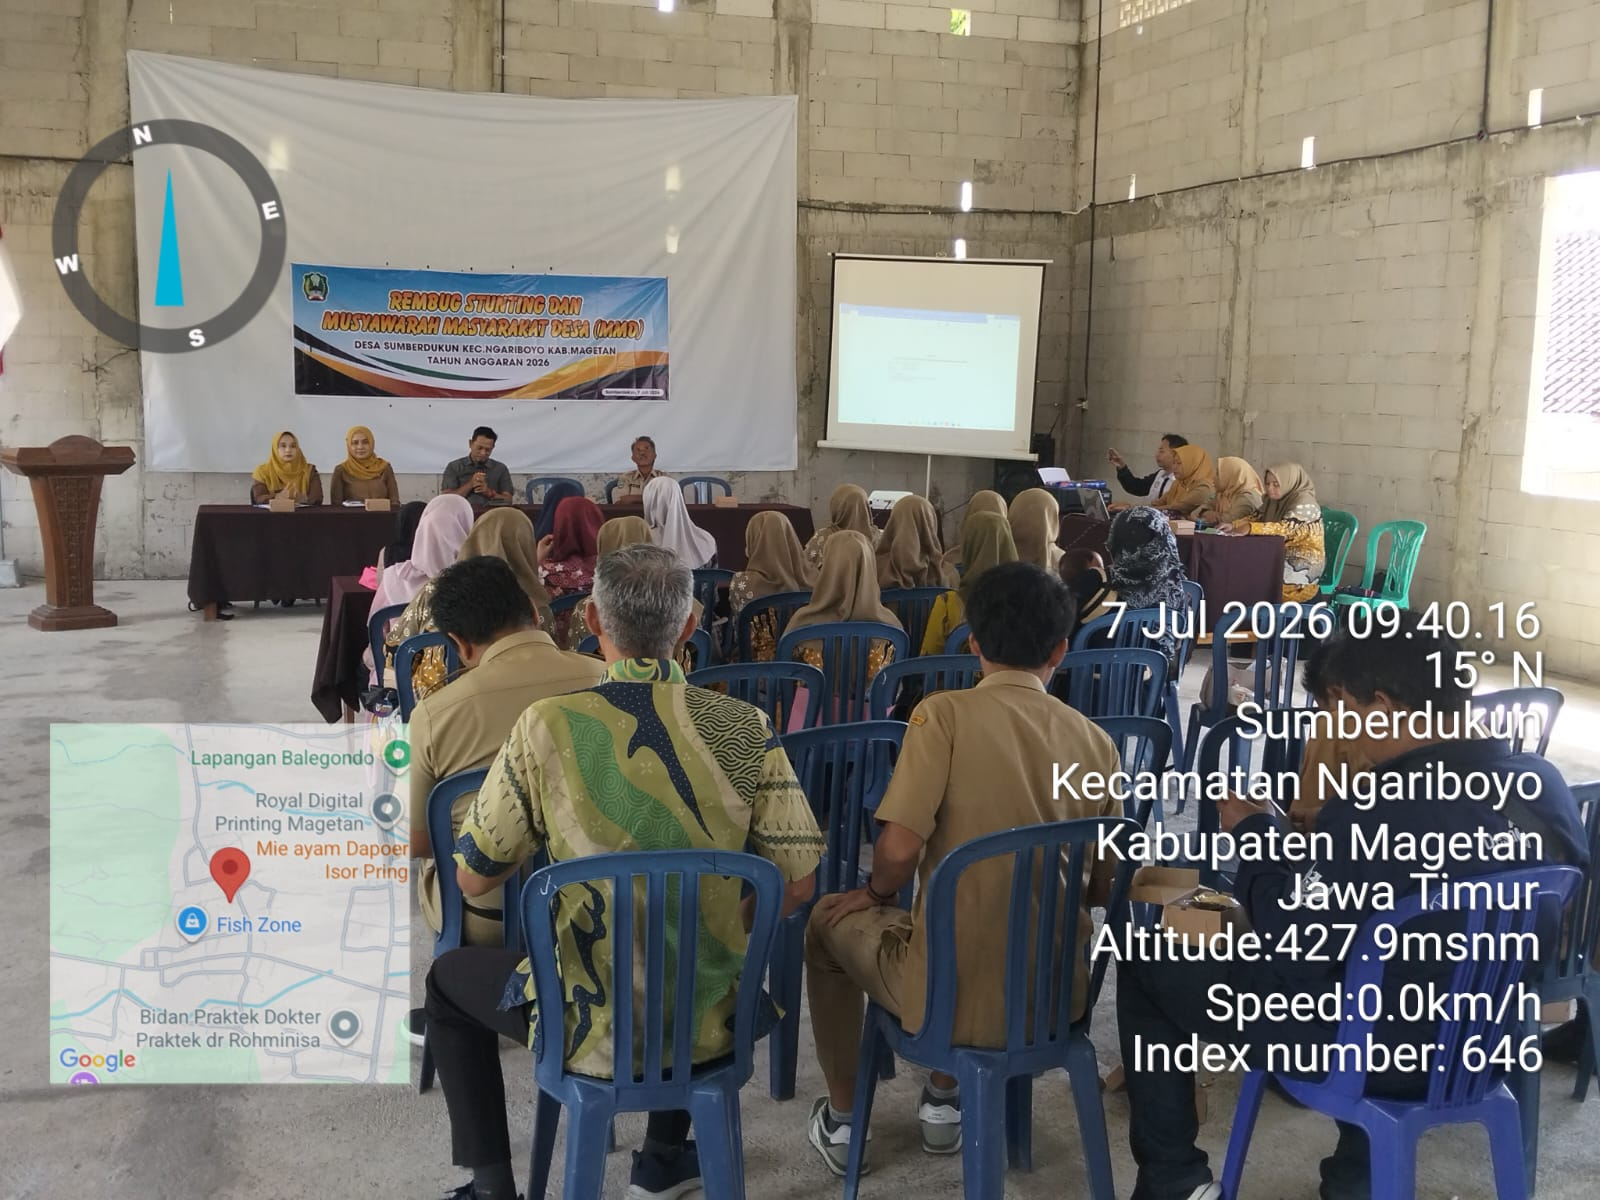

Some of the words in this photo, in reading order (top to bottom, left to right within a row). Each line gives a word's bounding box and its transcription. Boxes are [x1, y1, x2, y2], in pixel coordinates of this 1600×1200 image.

[389, 290, 463, 312] REMBUG
[464, 294, 546, 314] STUNTING
[548, 295, 583, 315] DAN
[321, 311, 441, 335] MUSYAWARAH
[442, 316, 549, 338] MASYARAKAT
[550, 319, 590, 338] DESA
[593, 318, 645, 340] (MMD)
[354, 340, 381, 350] DESA
[383, 341, 460, 353] SUMBERDUKUN
[462, 344, 545, 355] KEC.NGARIBOYO
[547, 346, 617, 356] KAB.MAGETAN
[427, 356, 461, 366] TAHUN
[464, 357, 523, 367] ANGGARAN
[526, 358, 550, 368] 2026
